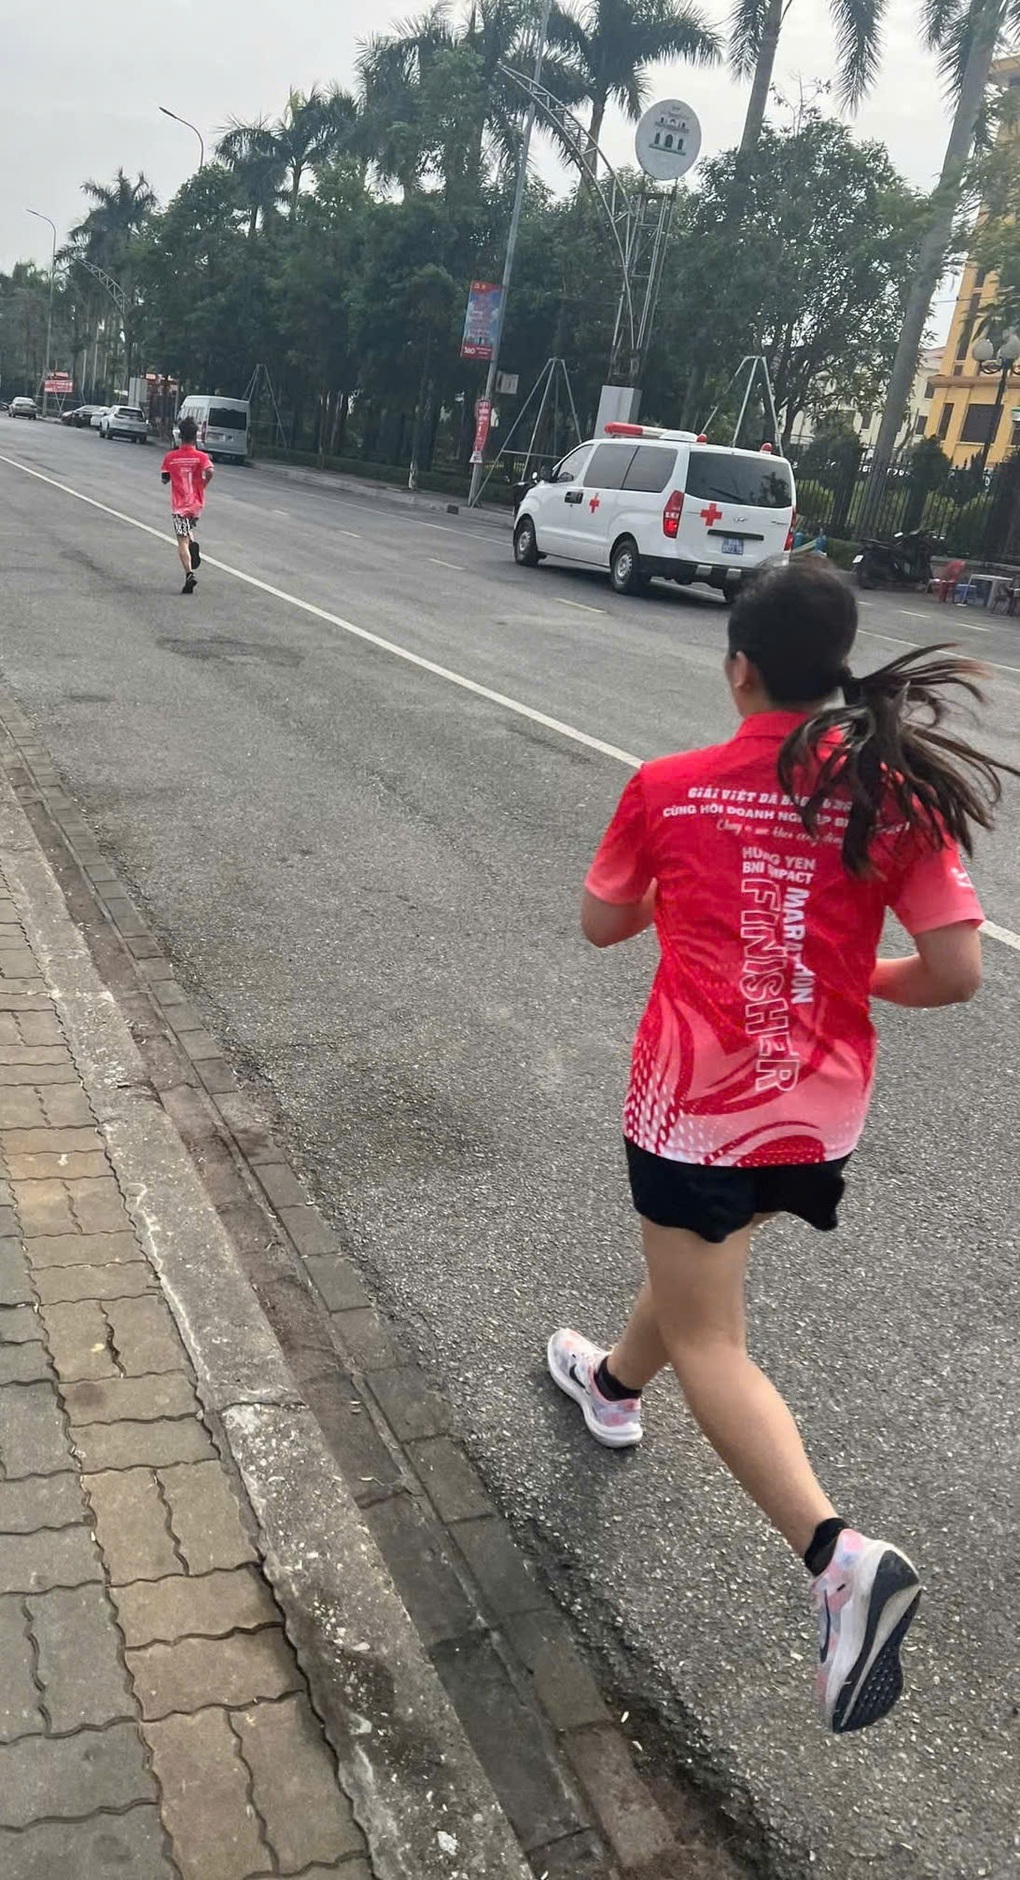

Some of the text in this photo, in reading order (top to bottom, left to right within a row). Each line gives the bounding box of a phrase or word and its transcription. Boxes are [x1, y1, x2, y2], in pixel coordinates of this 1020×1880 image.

[727, 806, 775, 820] DOANH
[742, 861, 814, 884] BNI IMPACT
[740, 877, 801, 1092] FINISHER
